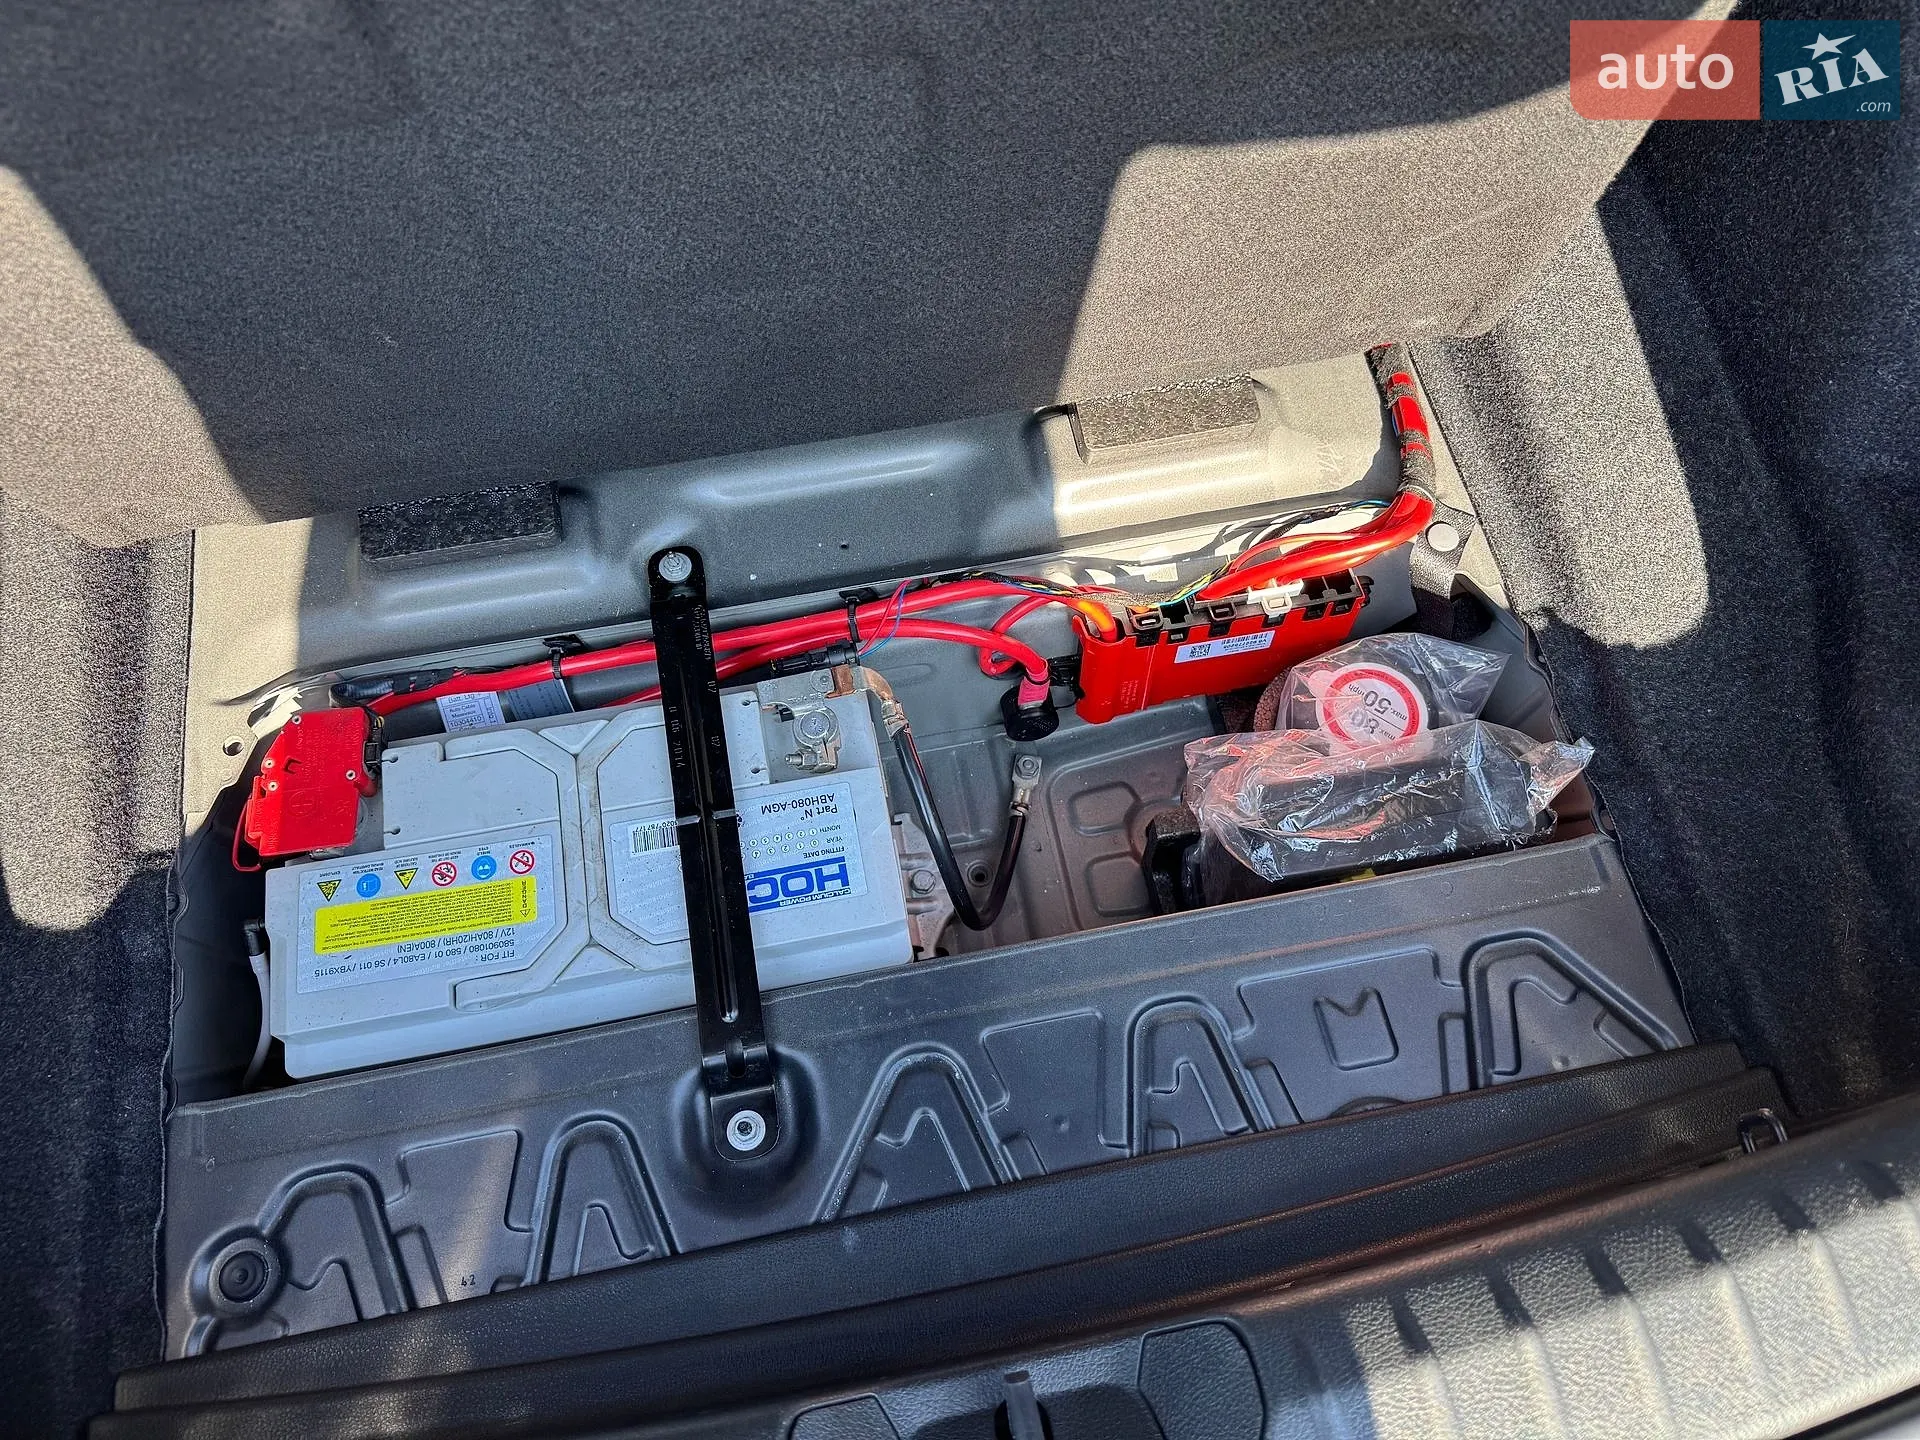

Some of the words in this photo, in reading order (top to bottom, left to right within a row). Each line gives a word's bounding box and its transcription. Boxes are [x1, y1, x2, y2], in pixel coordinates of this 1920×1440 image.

[1348, 684, 1364, 696] mph
[1363, 690, 1392, 715] 50
[1390, 708, 1408, 721] max.
[760, 792, 835, 814] ABH080-AGM
[815, 804, 837, 816] Part
[819, 824, 840, 832] MONTH
[826, 835, 842, 843] YEAR
[802, 850, 819, 858] DATE
[820, 845, 844, 854] FITTING
[519, 880, 529, 908] DANGER
[811, 888, 850, 900] CALCIUM
[779, 895, 811, 906] POWER
[499, 926, 515, 937] 12V
[441, 930, 493, 946] 80AH(20HR)
[396, 938, 435, 953] 800A(EN)
[468, 938, 514, 953] 580901080
[432, 949, 443, 958] 01
[445, 946, 461, 957] 580
[479, 951, 499, 961] FOR
[501, 949, 514, 958] FIT
[373, 958, 385, 968] S6
[392, 952, 426, 965] EA80L4
[358, 960, 372, 970] 011
